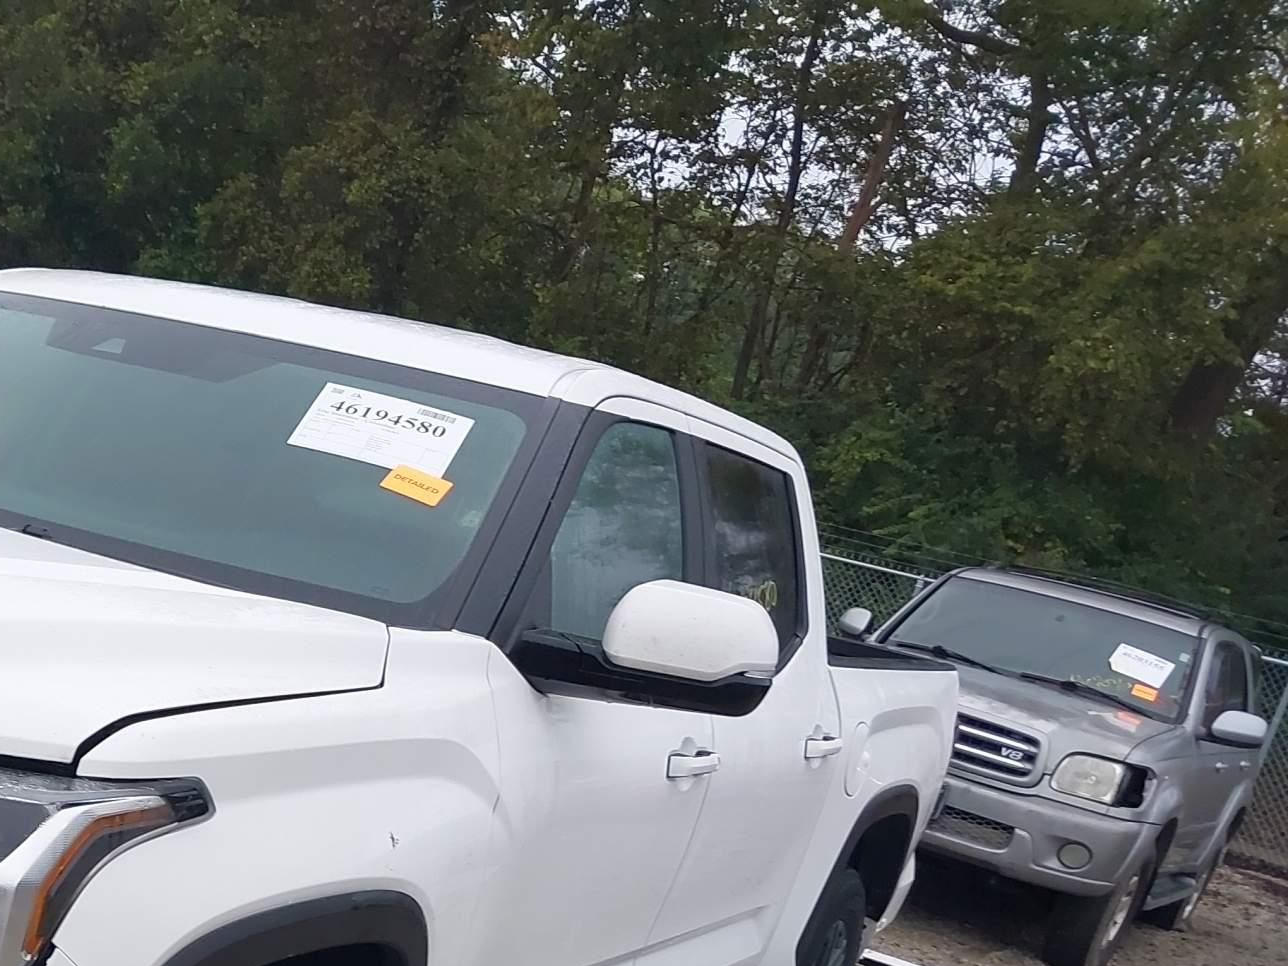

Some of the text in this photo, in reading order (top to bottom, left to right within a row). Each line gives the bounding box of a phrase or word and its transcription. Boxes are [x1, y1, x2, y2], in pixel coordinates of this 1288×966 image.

[330, 400, 447, 438] 46194580
[392, 473, 440, 495] DETAILED
[1000, 746, 1024, 760] V8
